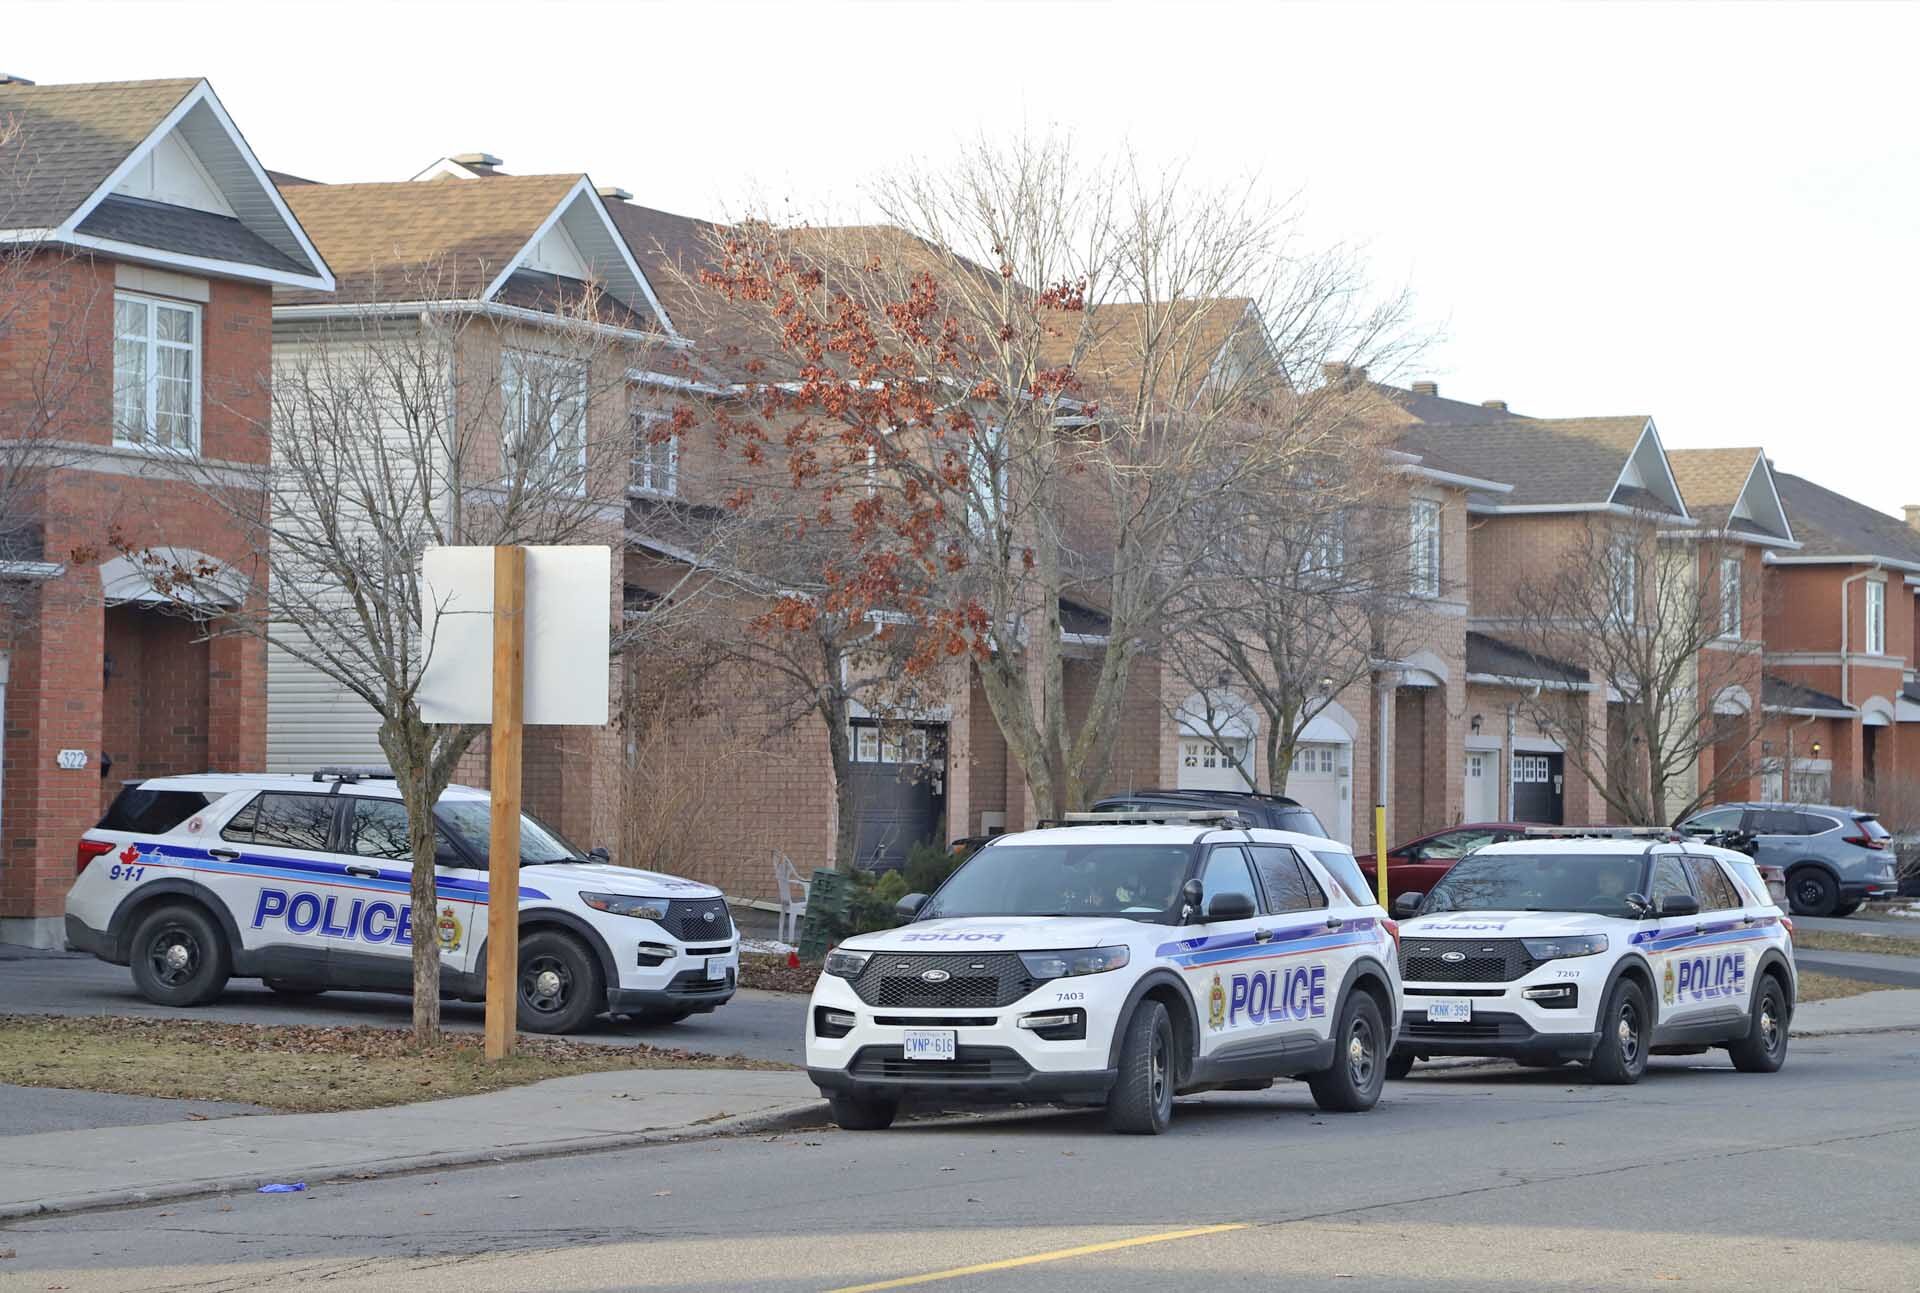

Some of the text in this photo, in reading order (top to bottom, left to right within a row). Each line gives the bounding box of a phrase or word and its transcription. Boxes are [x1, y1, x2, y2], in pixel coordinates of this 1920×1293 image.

[1679, 952, 1745, 1002] POLICE
[1056, 992, 1084, 1002] 7403
[1230, 965, 1326, 1027] POLICE
[1454, 1004, 1469, 1016] 399
[905, 1038, 953, 1052] CVNP 616
